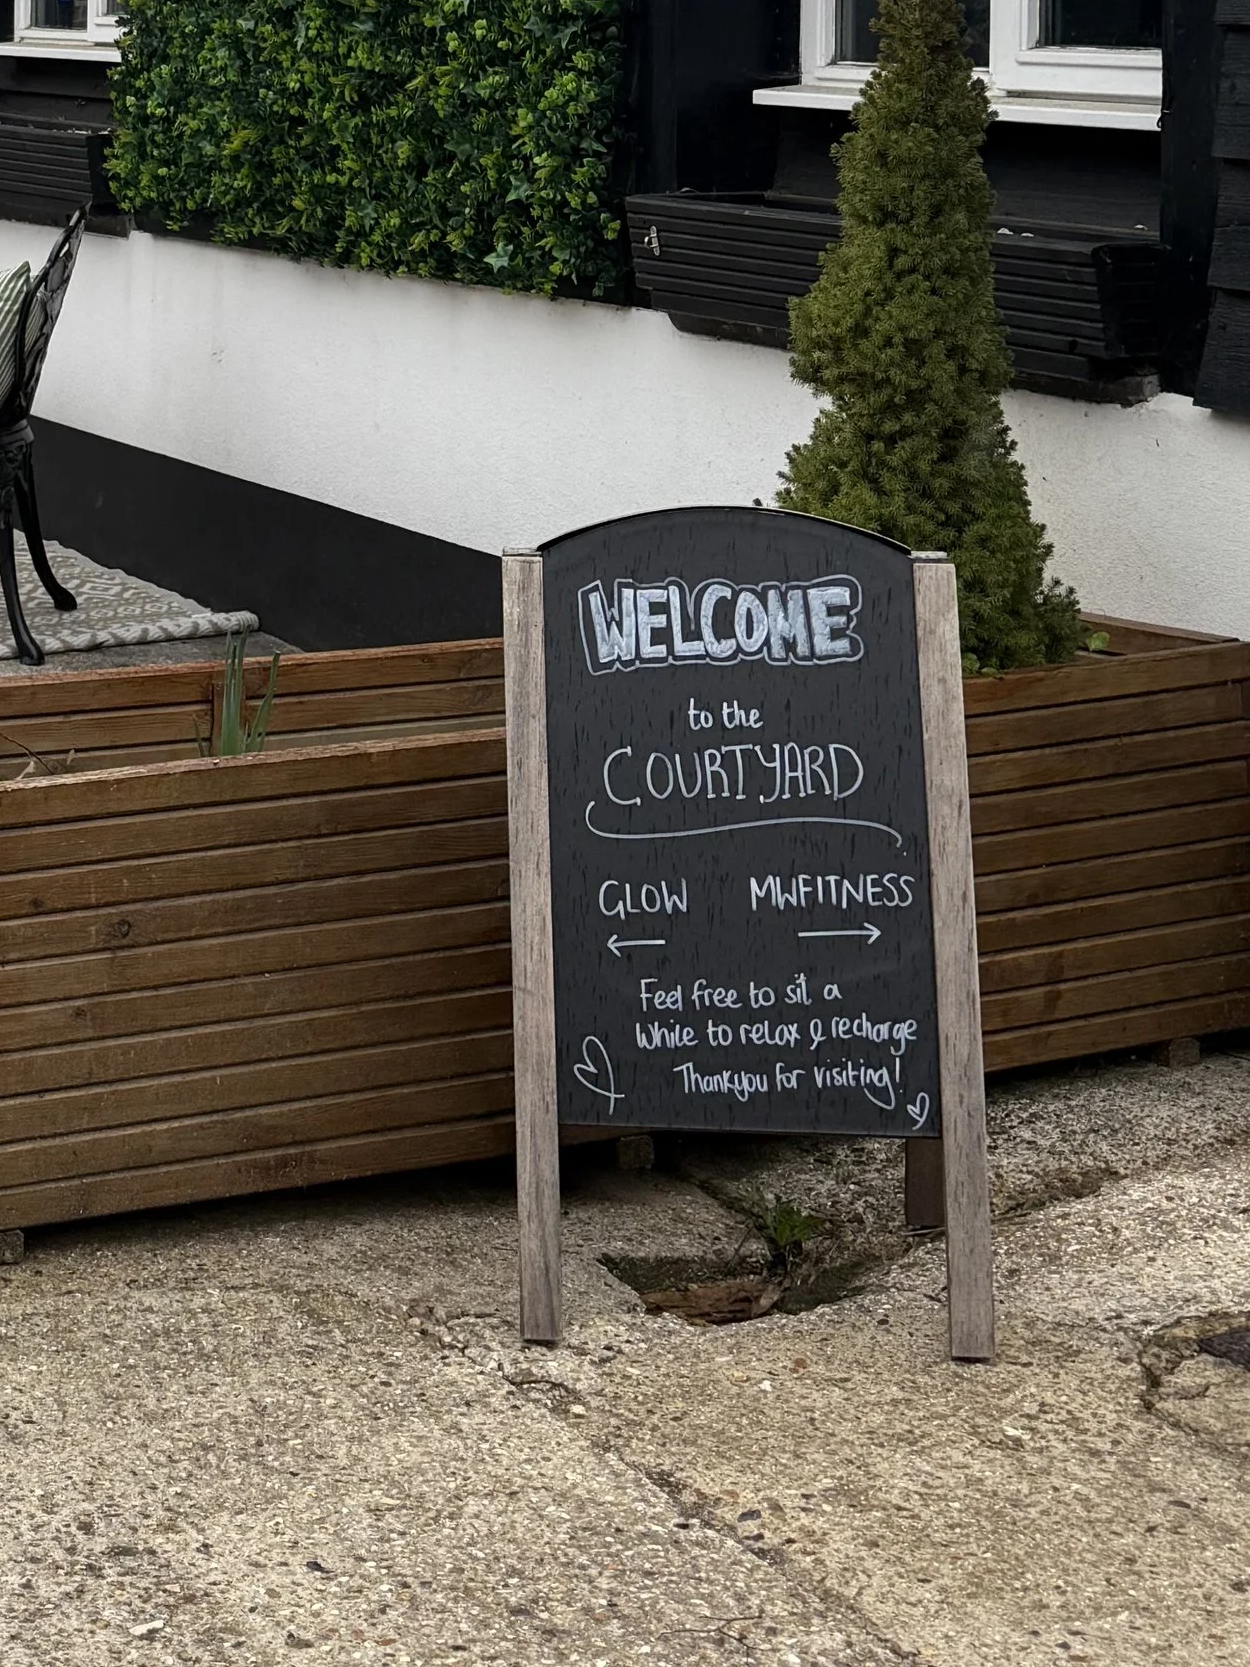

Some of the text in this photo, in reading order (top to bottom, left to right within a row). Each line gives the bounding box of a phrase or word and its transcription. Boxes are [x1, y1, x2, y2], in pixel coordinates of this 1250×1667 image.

[585, 581, 856, 666] WELCOME
[687, 697, 764, 730] to the
[603, 742, 865, 807] COURTYARD
[598, 877, 689, 920] GLOW
[750, 873, 916, 911] MWFITNESS
[639, 972, 843, 1011] Feel free to sit a
[706, 1019, 733, 1046] to
[740, 1019, 801, 1048] relax
[831, 1012, 918, 1056] recharge
[775, 1062, 807, 1094] for
[813, 1057, 904, 1110] visiting!
